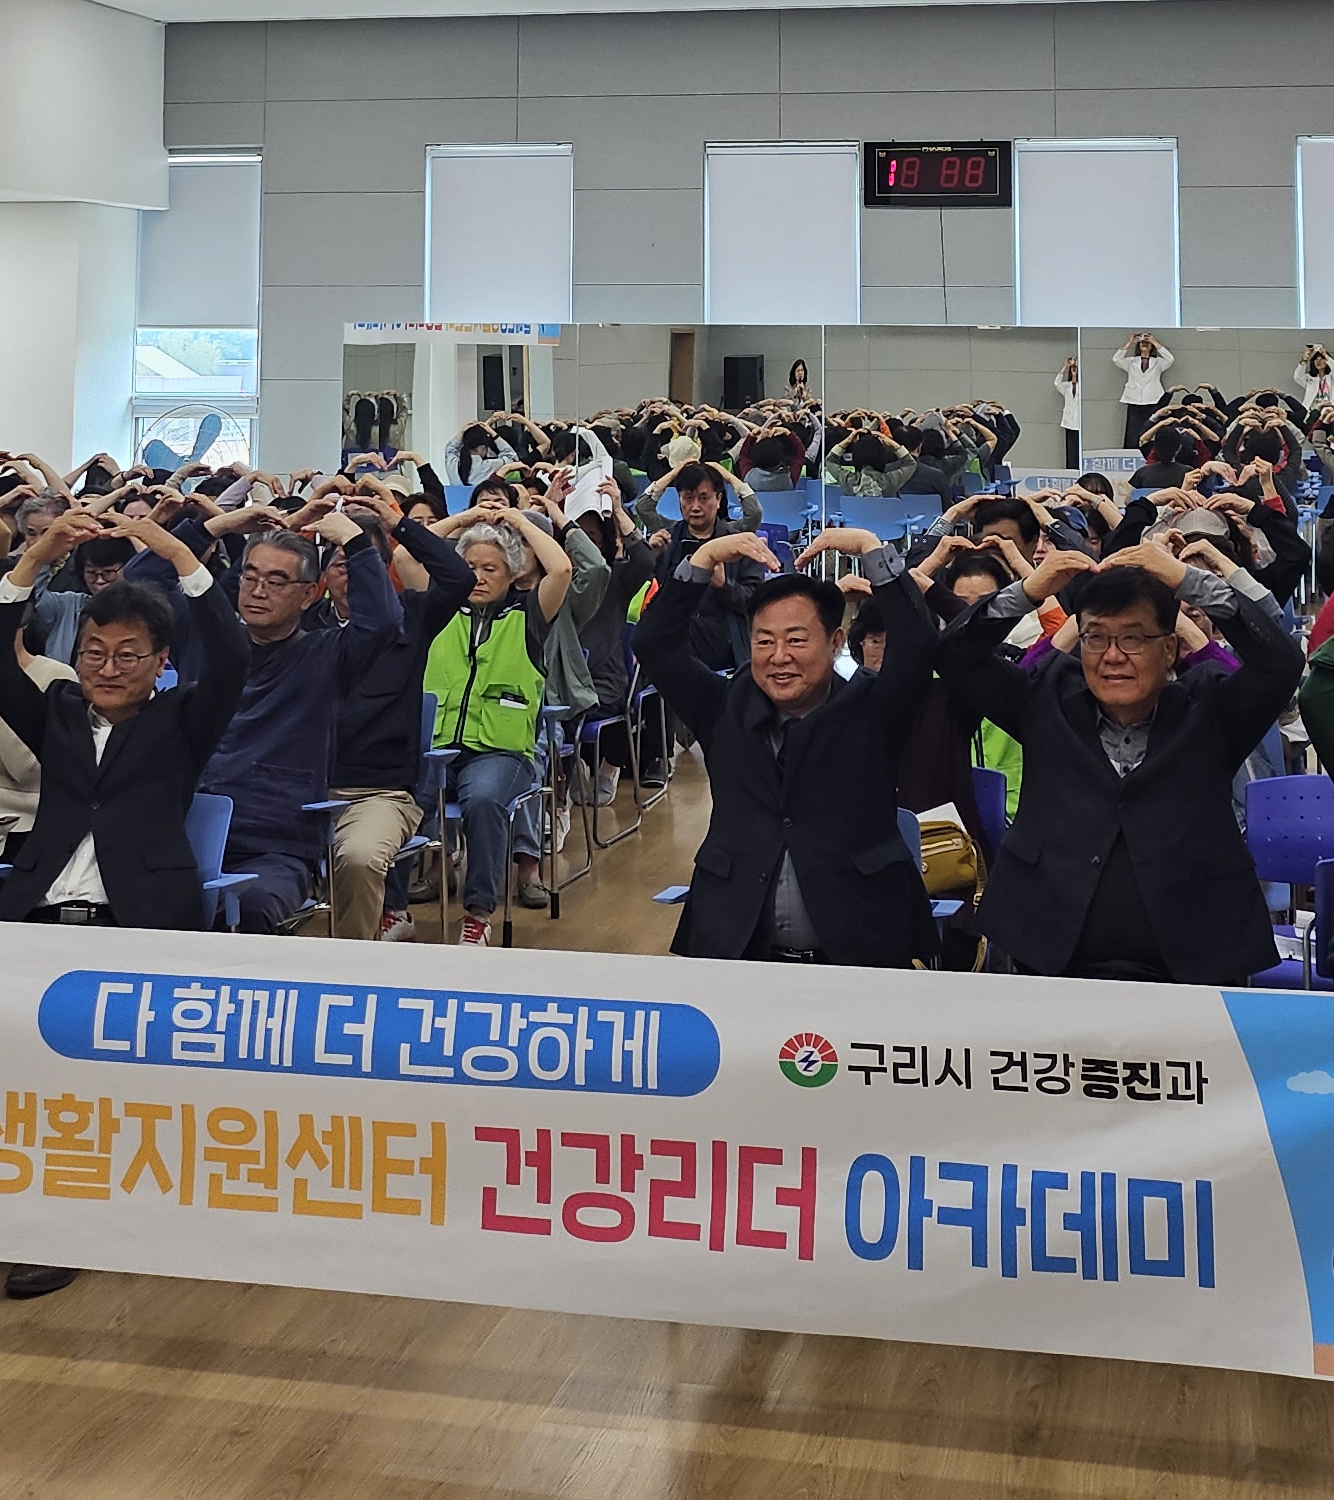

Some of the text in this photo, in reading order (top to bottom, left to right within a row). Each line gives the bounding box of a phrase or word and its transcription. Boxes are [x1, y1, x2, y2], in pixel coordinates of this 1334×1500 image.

[171, 982, 297, 1068] 함께
[315, 994, 377, 1072] 더
[398, 998, 661, 1090] 건강하게
[847, 1042, 1209, 1105] 구리시 건강증진과
[474, 1126, 818, 1261] 건강리더
[844, 1153, 1216, 1289] 아카데미
